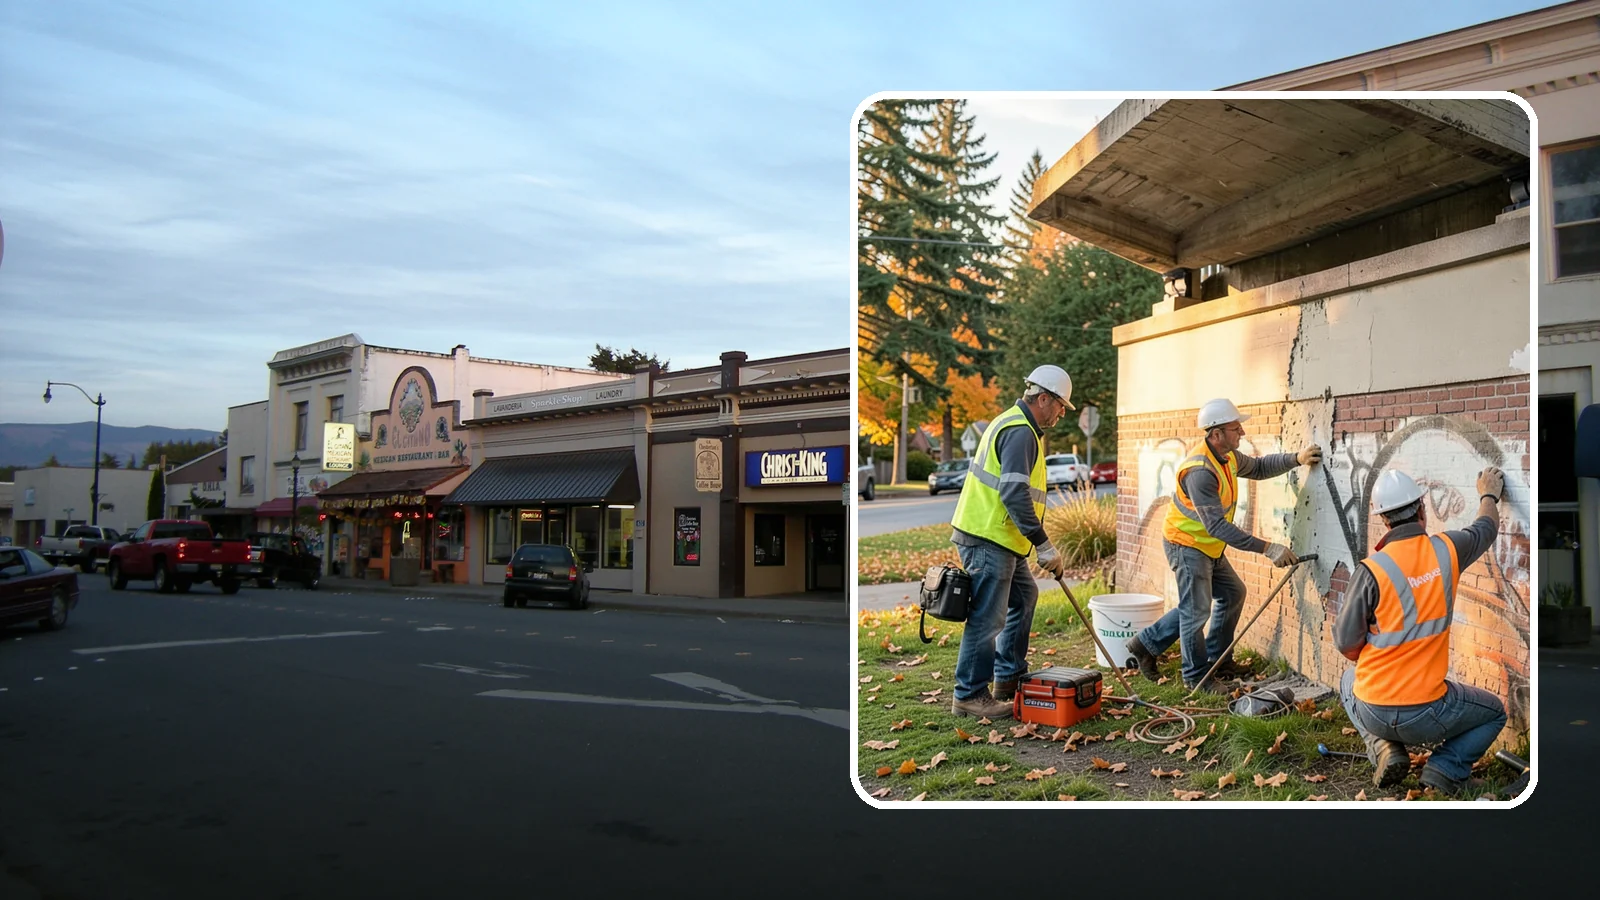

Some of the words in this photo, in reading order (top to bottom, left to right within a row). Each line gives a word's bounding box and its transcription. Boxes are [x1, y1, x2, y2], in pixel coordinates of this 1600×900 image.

[493, 402, 522, 412] LAVANDERIA
[531, 398, 561, 408] Sparkle
[562, 394, 582, 405] Shop
[595, 389, 624, 400] LAUNDRY
[397, 451, 433, 462] RESTAURANT
[438, 450, 450, 459] BAR
[761, 452, 797, 478] CHRIST
[799, 450, 827, 476] KING
